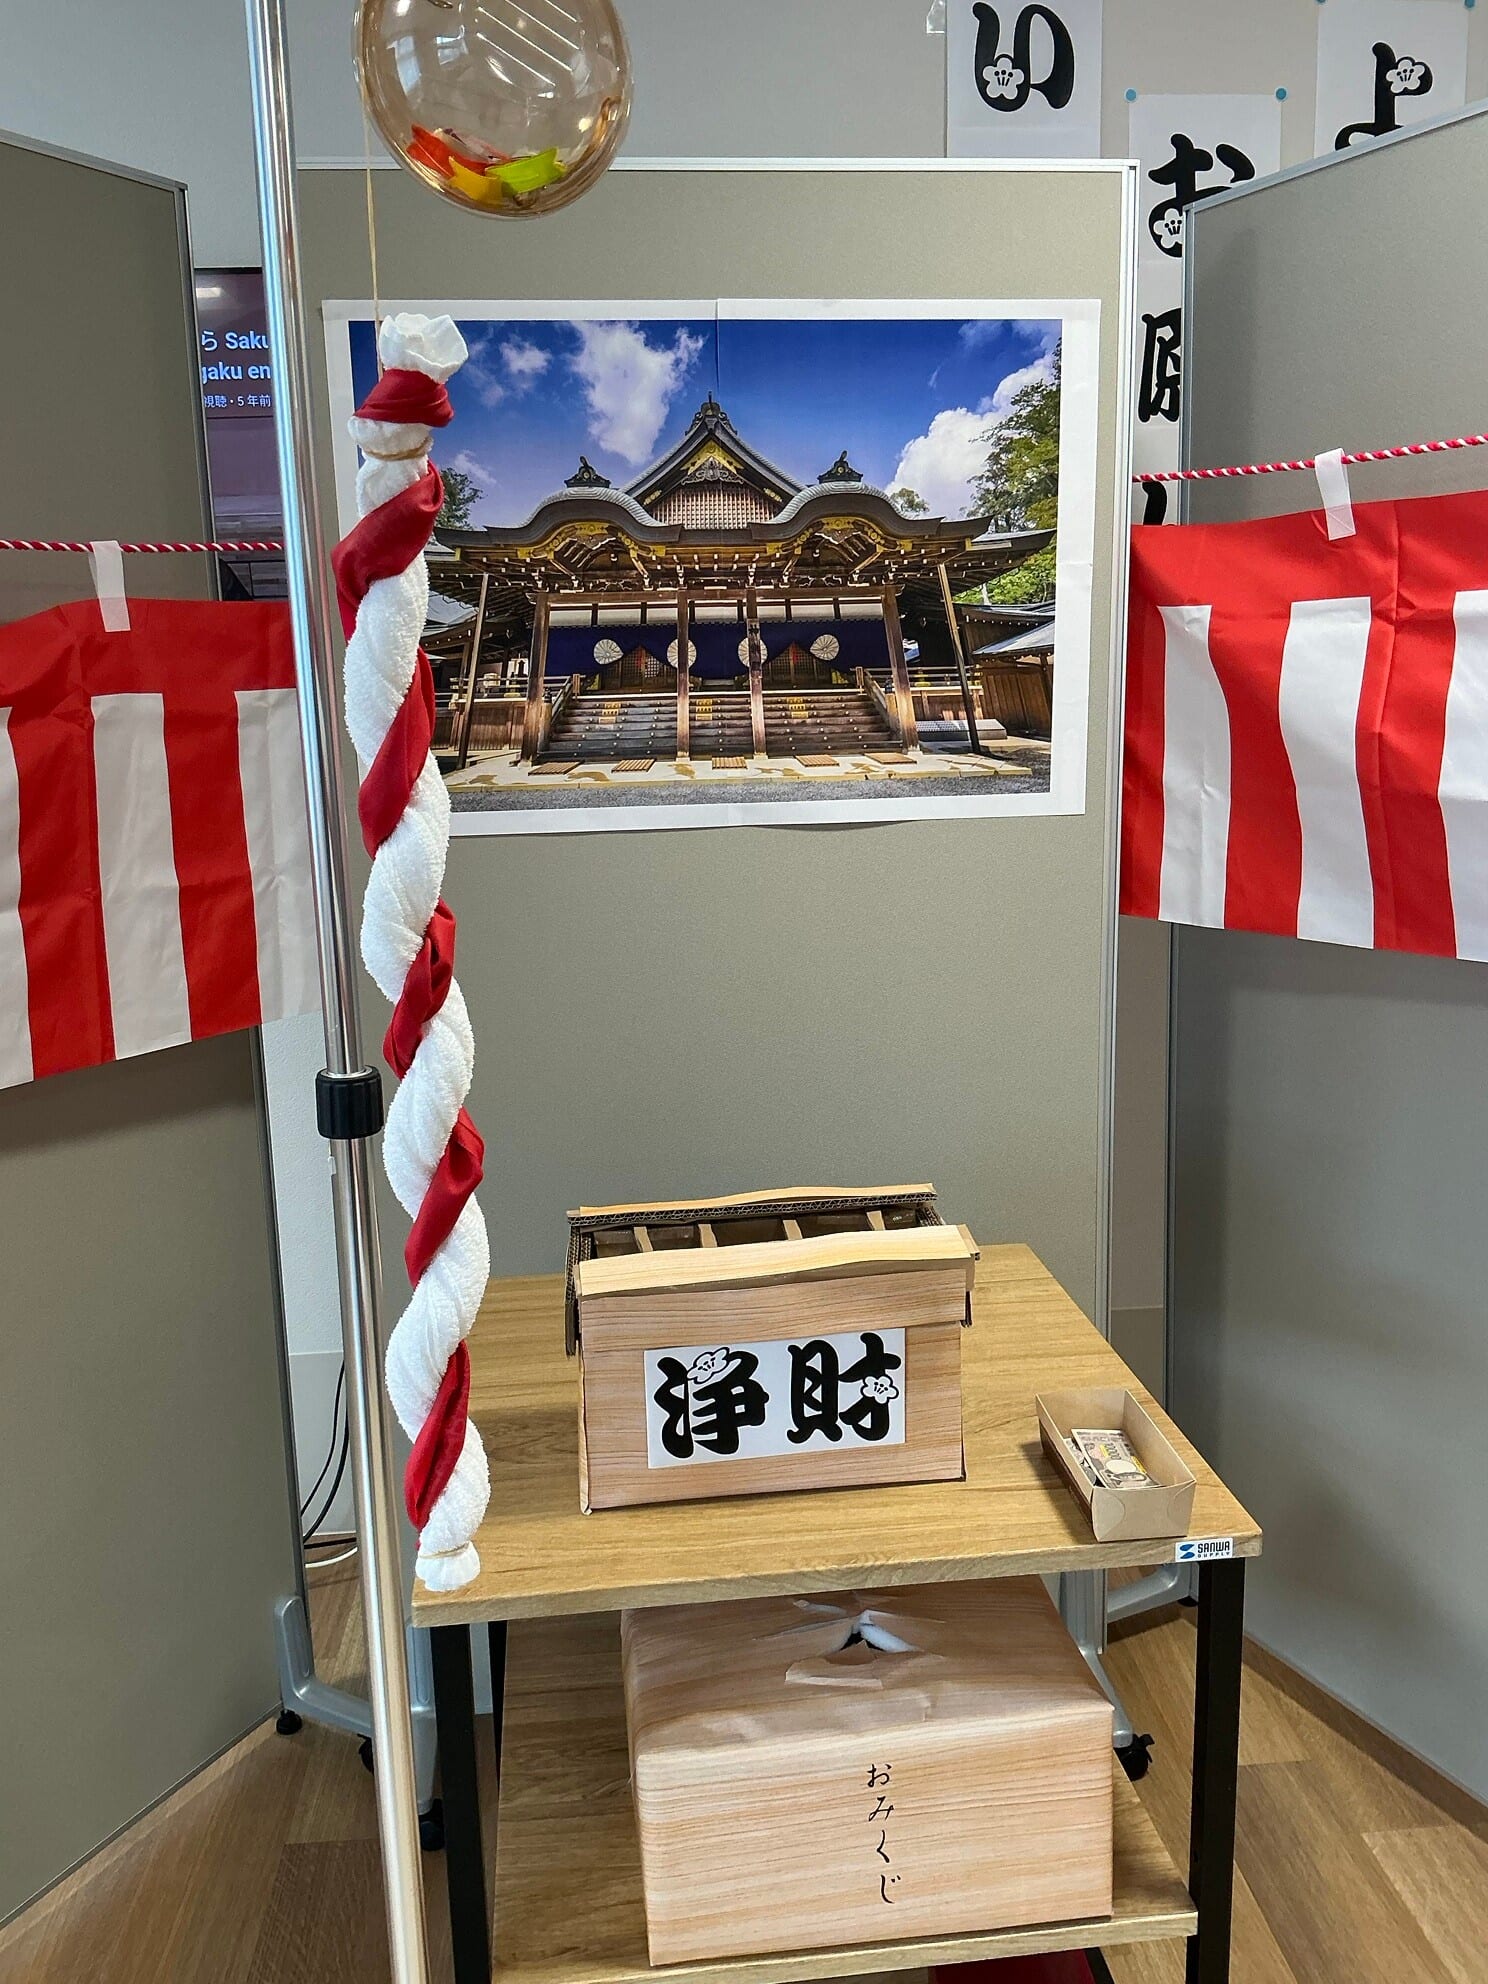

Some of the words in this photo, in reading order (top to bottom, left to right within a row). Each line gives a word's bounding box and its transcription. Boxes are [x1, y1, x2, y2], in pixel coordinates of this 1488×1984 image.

[972, 1, 1075, 113] い
[201, 330, 218, 351] ら
[654, 1332, 902, 1459] 浄財
[1197, 1541, 1230, 1553] SANWA
[866, 1763, 902, 1904] おみくじ
